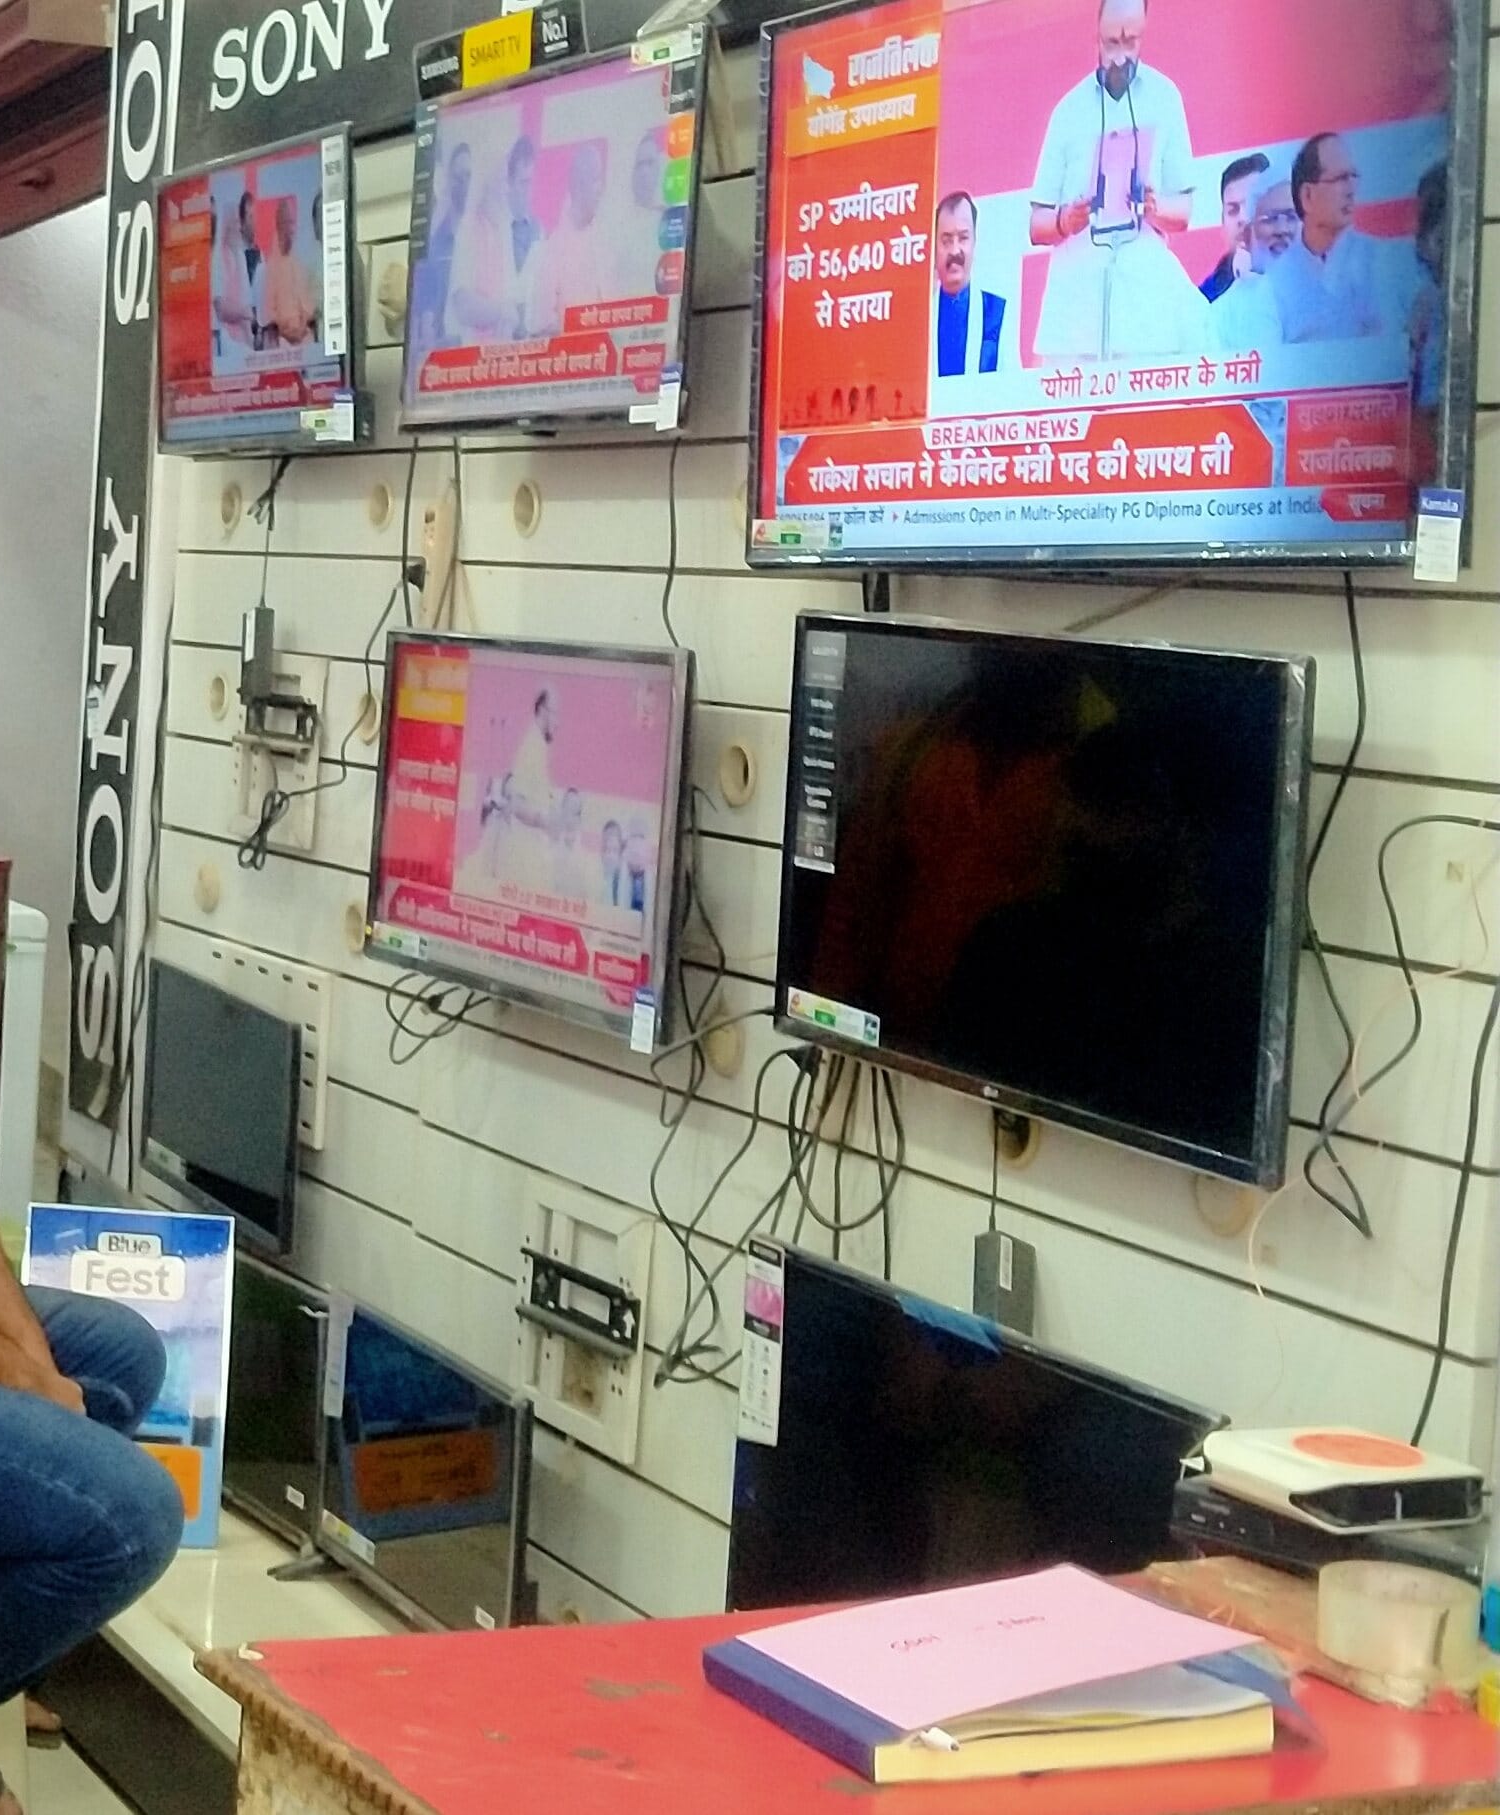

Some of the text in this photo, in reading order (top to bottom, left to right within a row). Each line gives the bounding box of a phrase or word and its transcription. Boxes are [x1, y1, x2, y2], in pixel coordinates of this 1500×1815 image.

[210, 0, 392, 111] SONY
[420, 55, 459, 80] SAMSUNG
[469, 38, 505, 67] SMART
[508, 34, 522, 57] TV
[847, 33, 941, 86] राजतिलक
[114, 0, 164, 325] SO
[799, 181, 919, 232] SP उम्मीदवार
[787, 225, 928, 282] को 56,640 वोट
[814, 289, 893, 329] से हराया
[1129, 365, 1192, 392] सरकार
[1197, 356, 1217, 386] के
[1225, 349, 1262, 384] मंत्री
[931, 417, 1079, 446] BREAKING NEWS
[808, 432, 1233, 492] राकेश सचान ने कैबिनेट मंत्री पद की शपथ ली
[1298, 437, 1396, 474] राजतिलक
[904, 508, 966, 526] Admissions
[969, 505, 1001, 524] Open
[1005, 503, 1017, 521] in
[1020, 498, 1117, 523] Multi-Speciality
[1122, 500, 1140, 519] PG
[1145, 498, 1202, 521] Diploma
[1207, 497, 1264, 517] Courses
[1268, 498, 1283, 515] at
[79, 477, 138, 1067] SONY
[108, 1234, 151, 1254] Blue
[86, 1259, 169, 1297] Fest
